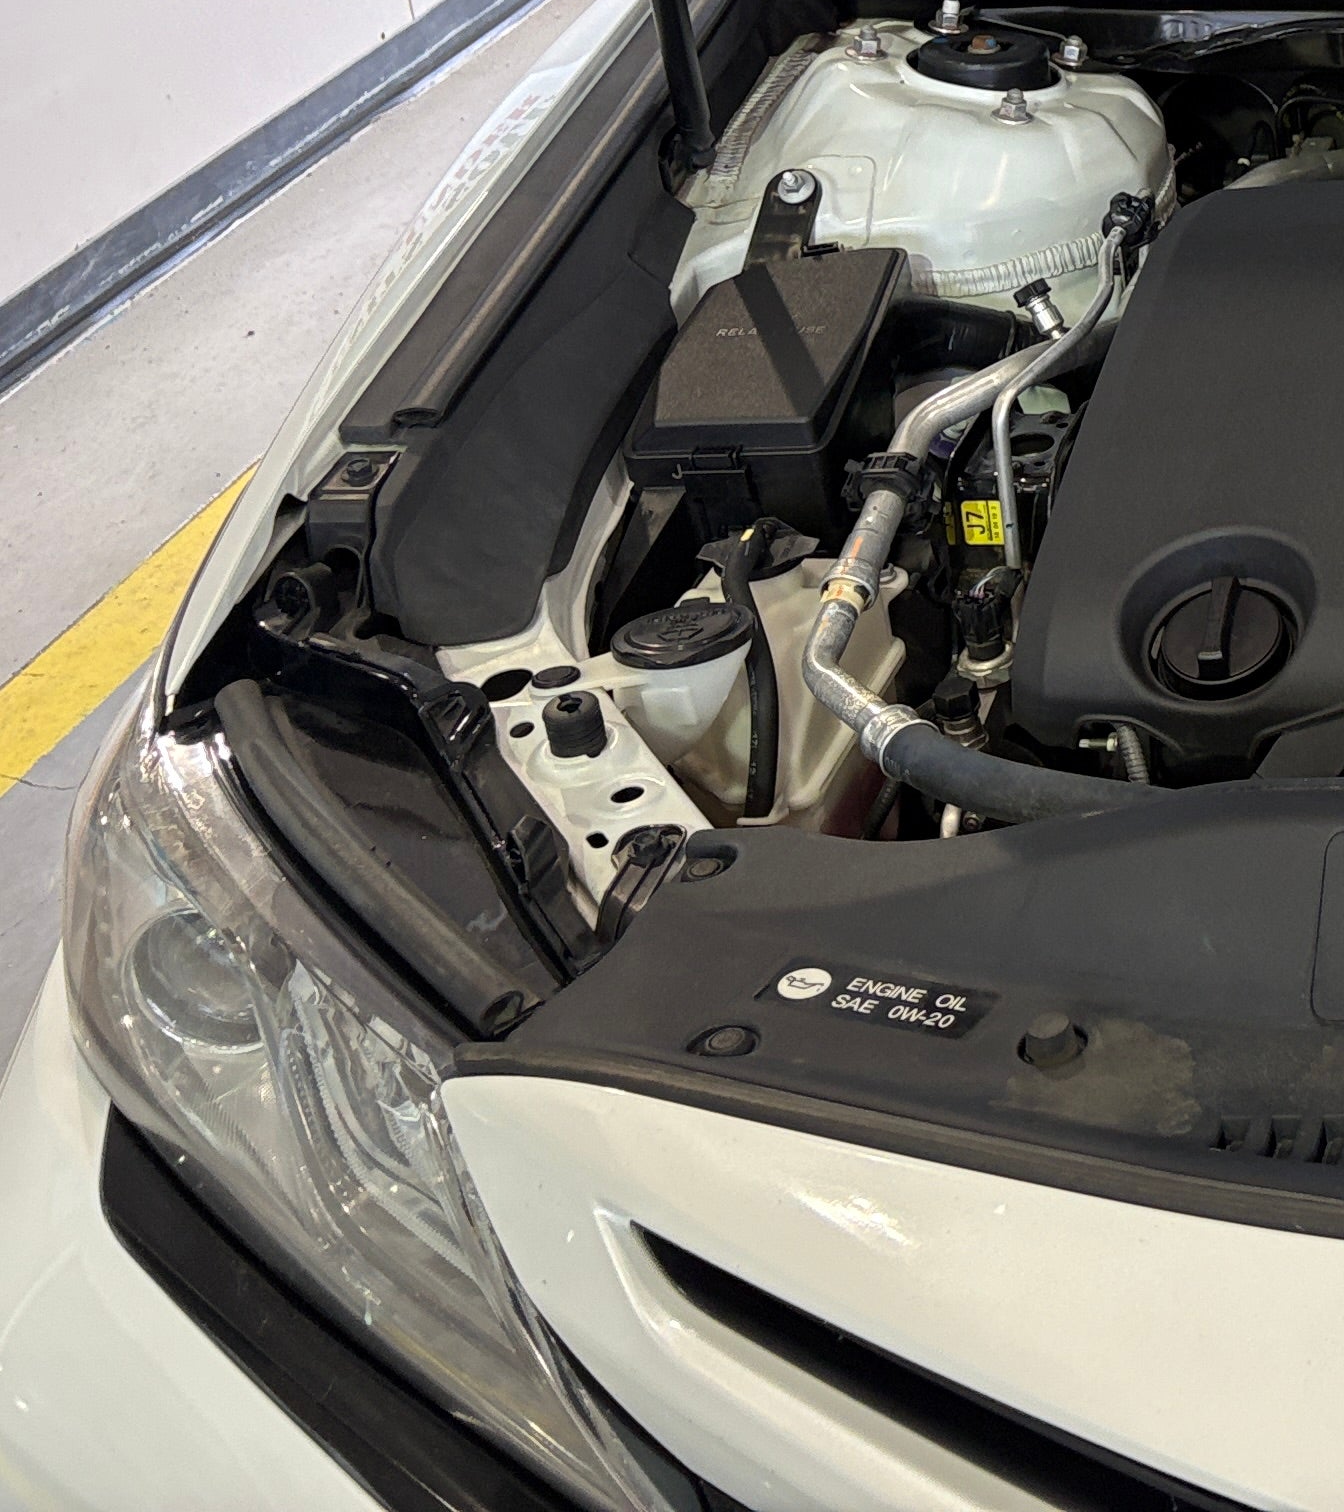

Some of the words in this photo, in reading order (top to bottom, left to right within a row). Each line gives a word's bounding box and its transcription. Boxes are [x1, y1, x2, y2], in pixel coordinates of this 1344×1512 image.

[715, 327, 758, 337] RELA
[965, 511, 985, 535] J7
[846, 977, 928, 1004] ENGINE
[935, 993, 969, 1012] OIL
[831, 994, 880, 1013] SAE
[887, 1005, 956, 1028] 0W-20
